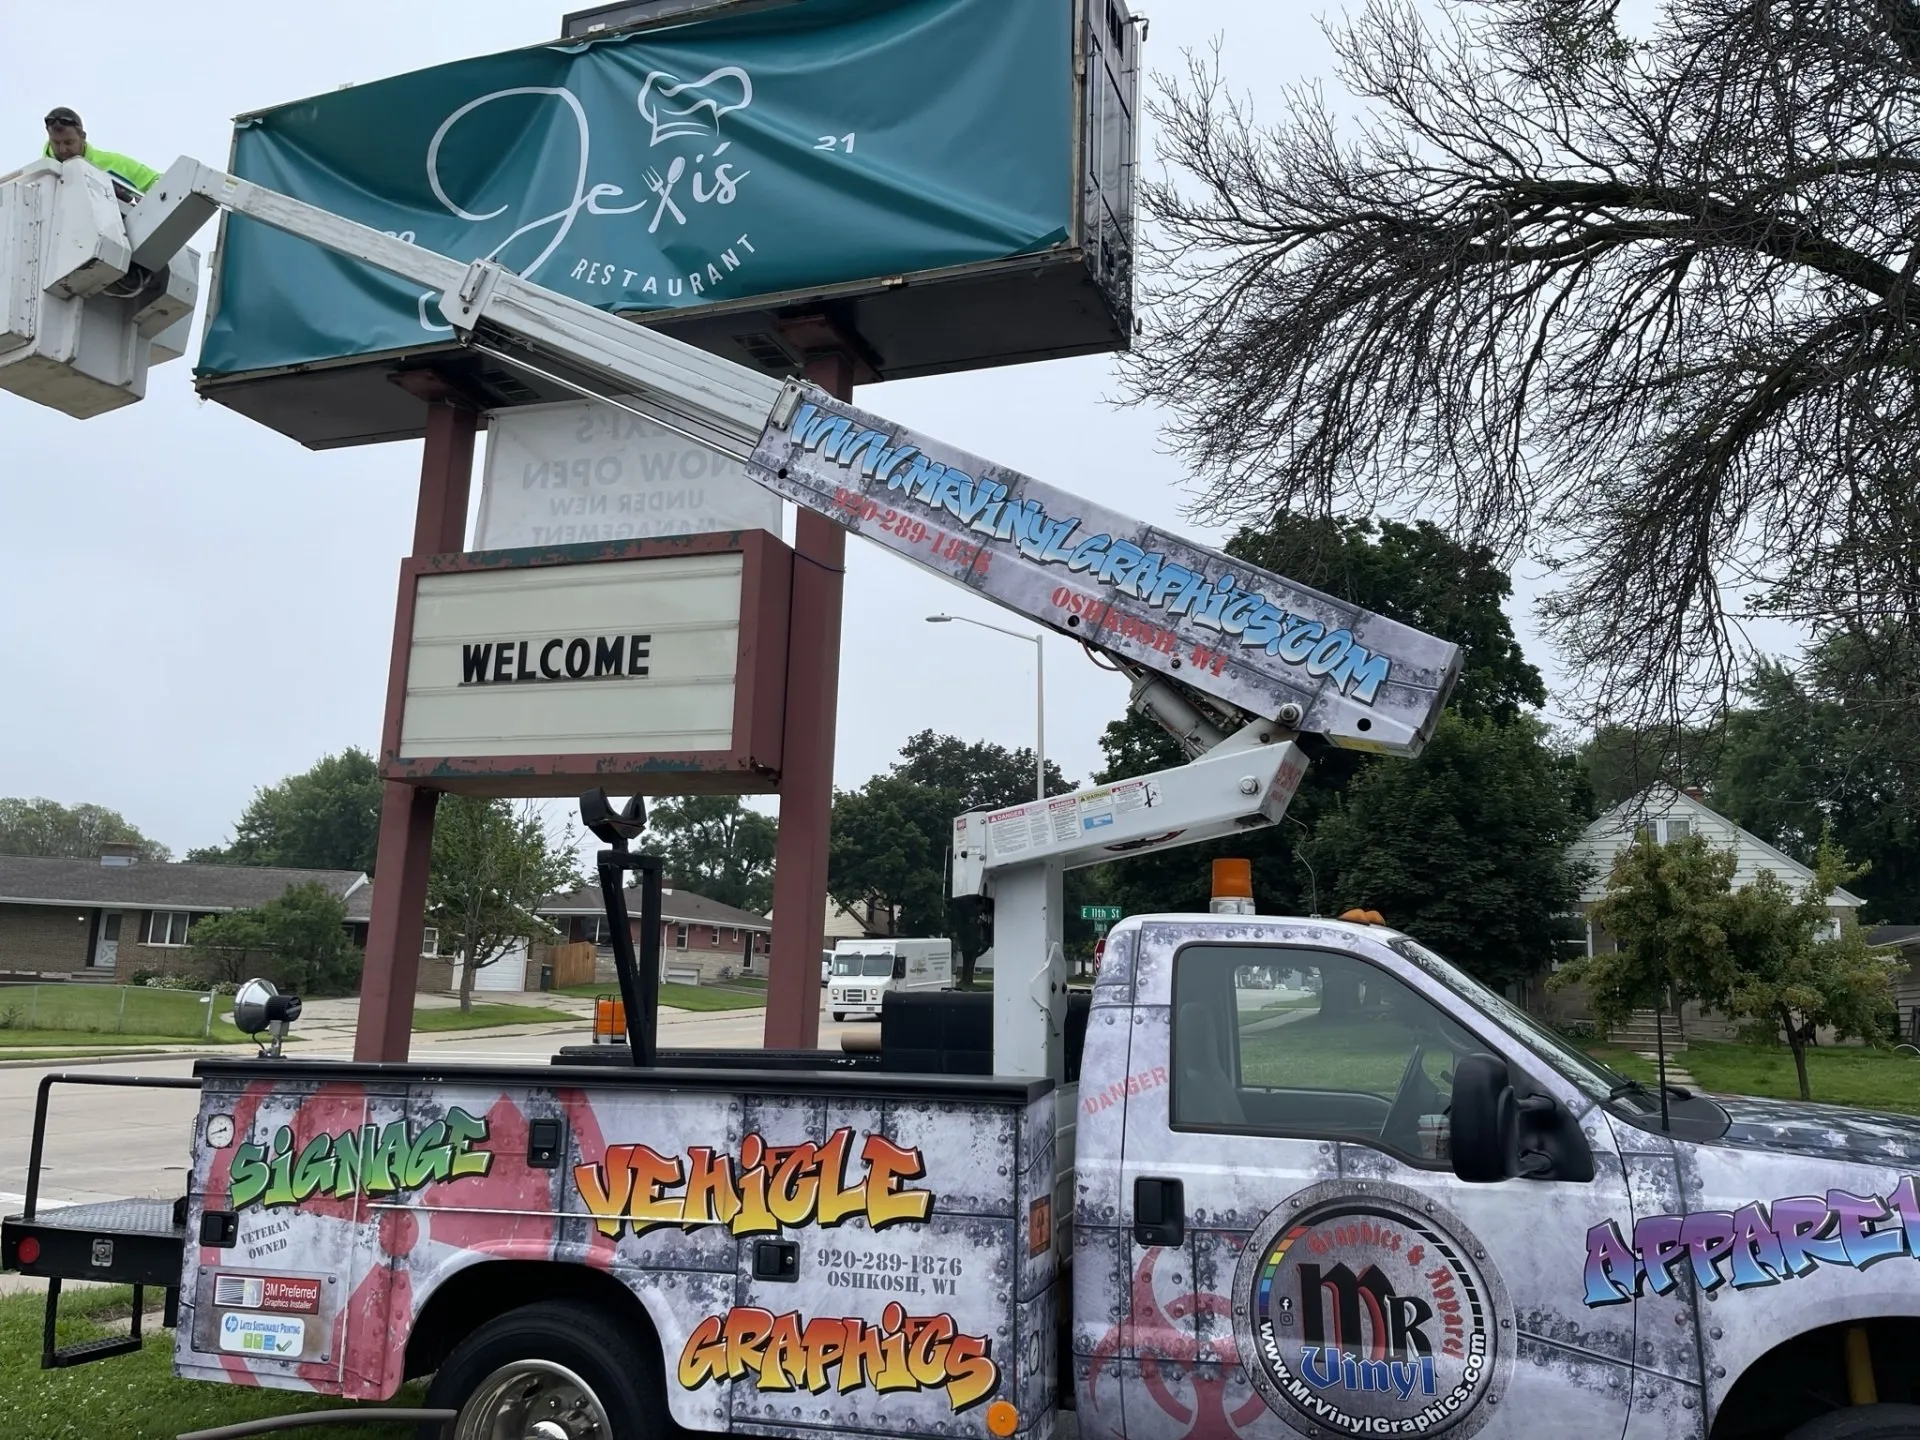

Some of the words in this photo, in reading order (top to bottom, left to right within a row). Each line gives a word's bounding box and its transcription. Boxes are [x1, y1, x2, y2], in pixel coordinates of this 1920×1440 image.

[813, 132, 856, 153] 21
[571, 233, 756, 297] RESTAURANT
[833, 487, 994, 575] 920-289-1876
[462, 634, 652, 684] WELCOME
[1191, 643, 1229, 679] WI
[997, 809, 1023, 821] DANGER
[1082, 908, 1088, 918] E
[1092, 908, 1106, 918] 11th
[1111, 908, 1120, 919] St
[1083, 1066, 1168, 1115] DANGER
[240, 1218, 291, 1246] VETERAN
[1306, 1221, 1403, 1256] Graphics
[248, 1238, 288, 1260] OWNED
[817, 1249, 963, 1277] 920-289-1876
[264, 1282, 278, 1296] 3M
[279, 1283, 318, 1299] Preferred
[827, 1270, 925, 1296] OSHKOSH,
[932, 1278, 957, 1296] WI
[264, 1297, 289, 1308] Graphics
[290, 1299, 313, 1309] Installer
[1259, 1320, 1486, 1434] www.MrVinylGraphics.com
[1300, 1347, 1438, 1401] Vinyl
